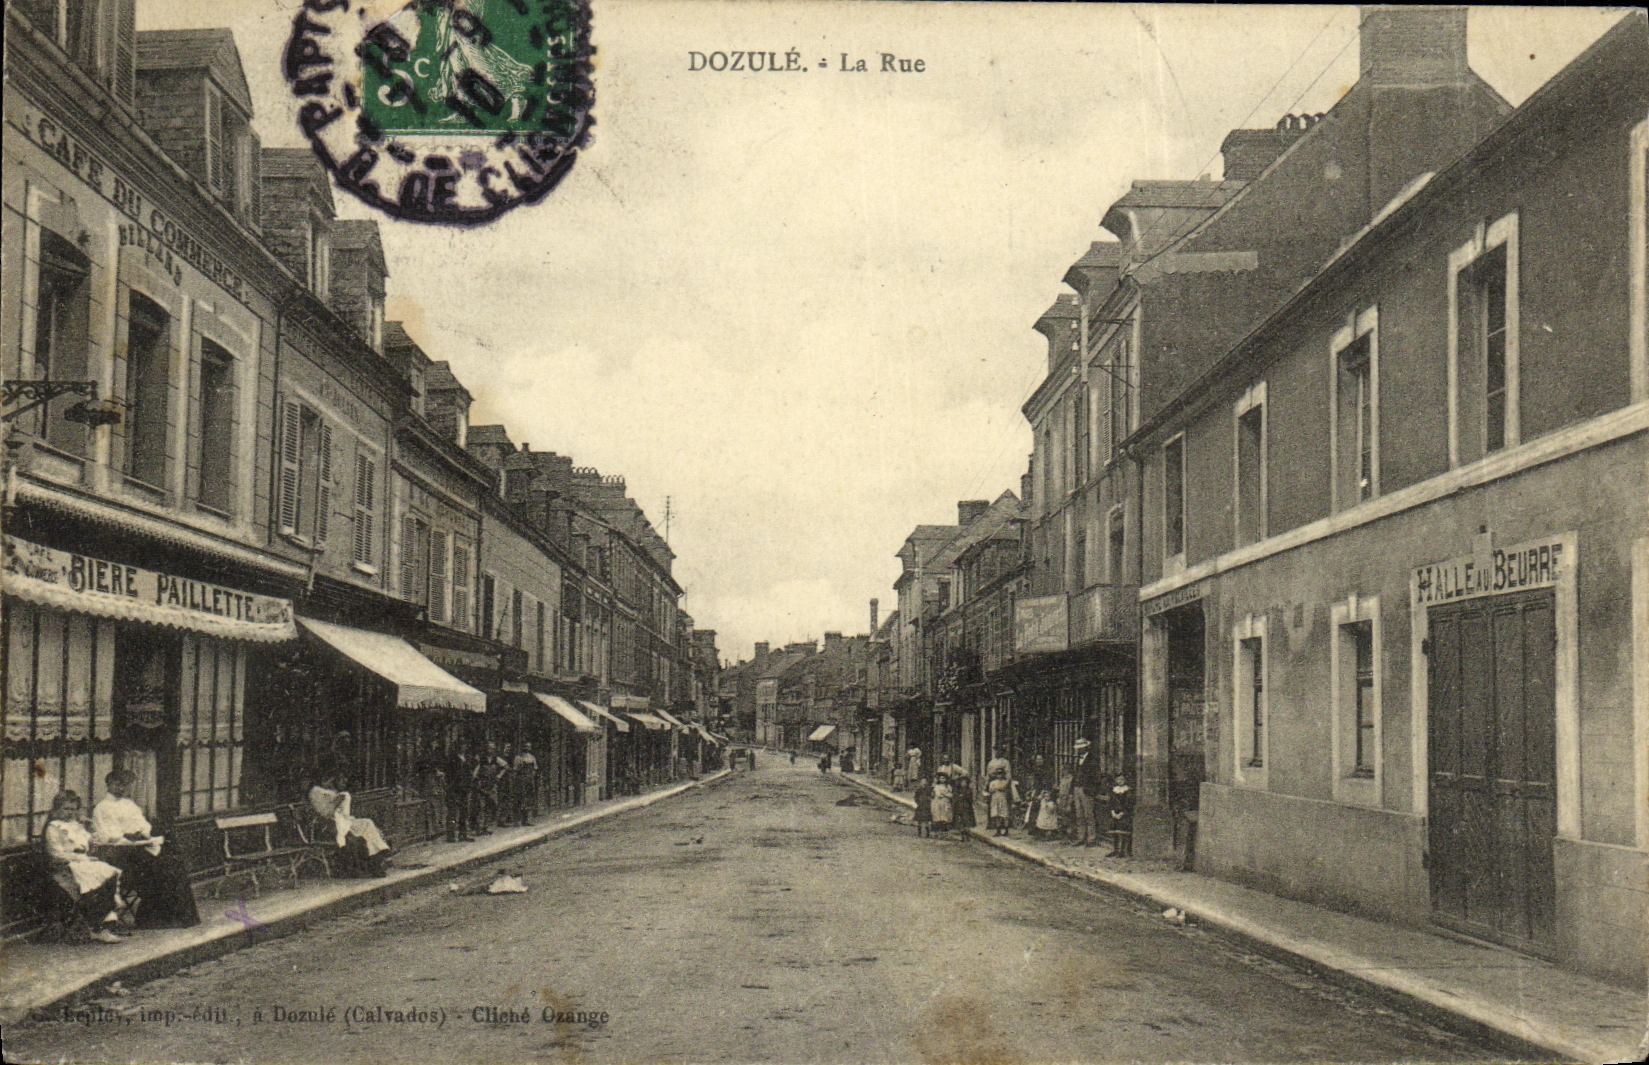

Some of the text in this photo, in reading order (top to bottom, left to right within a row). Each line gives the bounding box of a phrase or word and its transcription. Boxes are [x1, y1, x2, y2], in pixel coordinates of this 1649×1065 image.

[113, 177, 142, 218] DU
[155, 573, 255, 623] PAILLETTE
[1417, 543, 1564, 603] HALLE AU BEURRE
